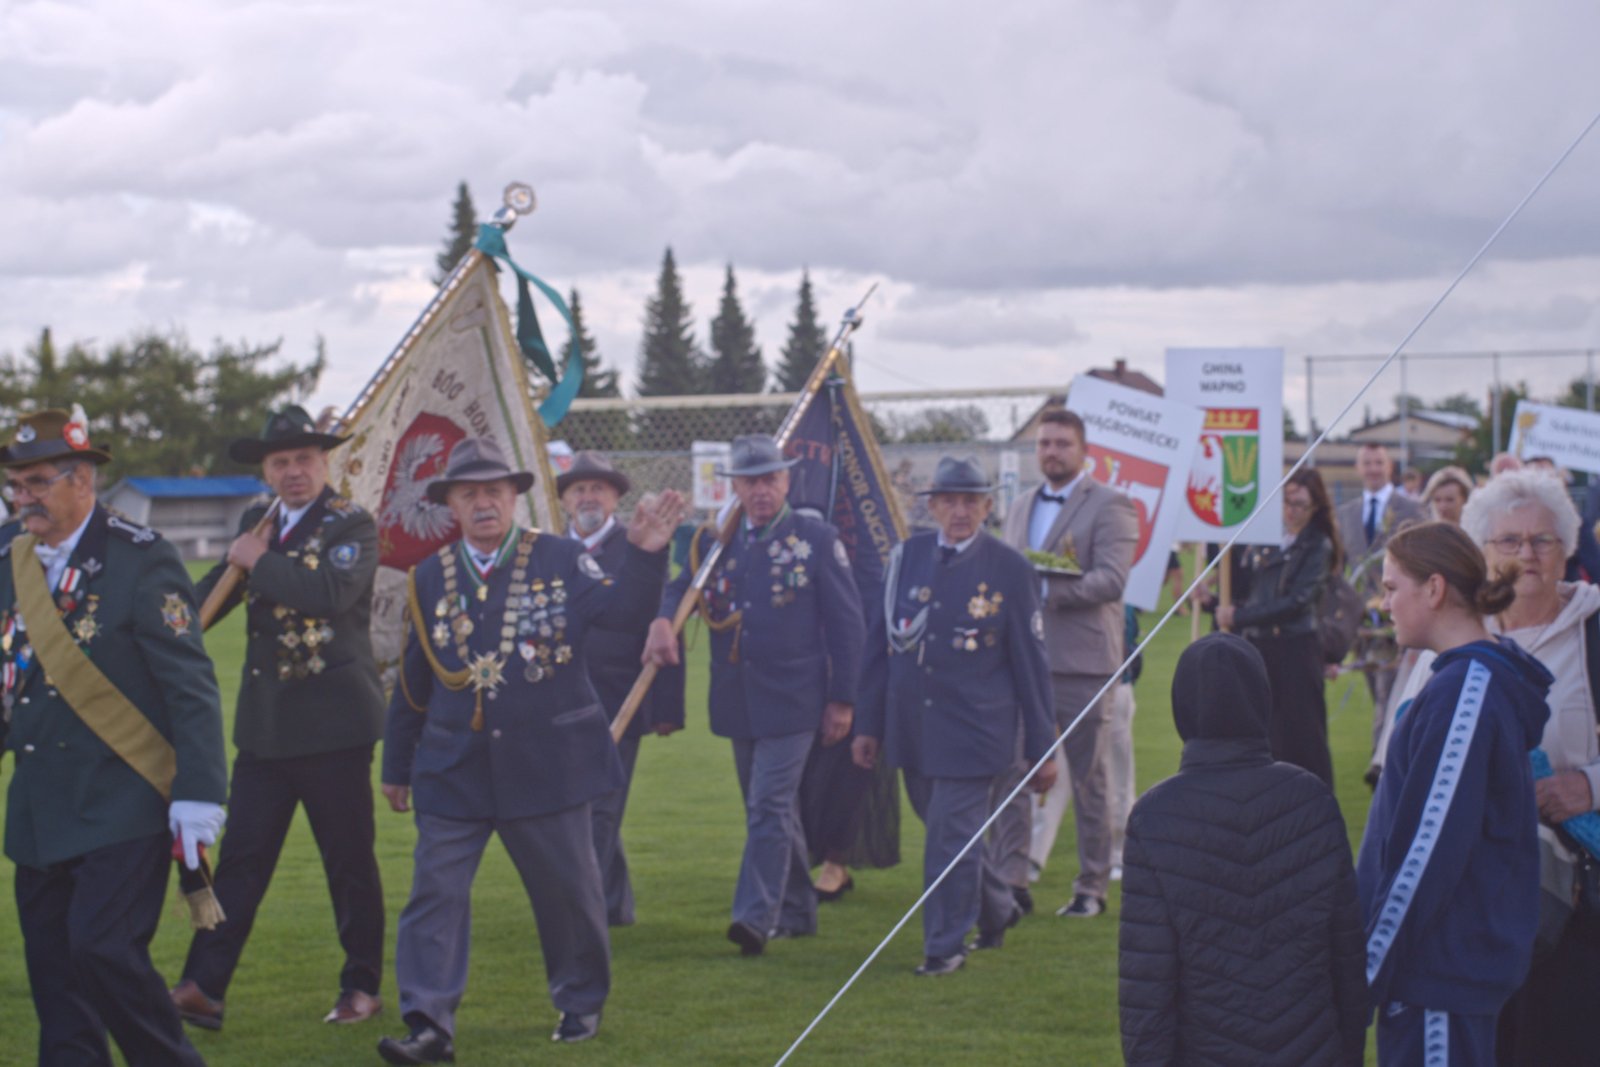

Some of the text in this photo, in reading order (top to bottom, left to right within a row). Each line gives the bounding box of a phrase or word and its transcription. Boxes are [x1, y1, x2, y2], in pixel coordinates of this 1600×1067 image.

[1202, 362, 1244, 375] GMINA
[1200, 380, 1246, 393] WAPNO
[1108, 399, 1162, 425] POWIAT
